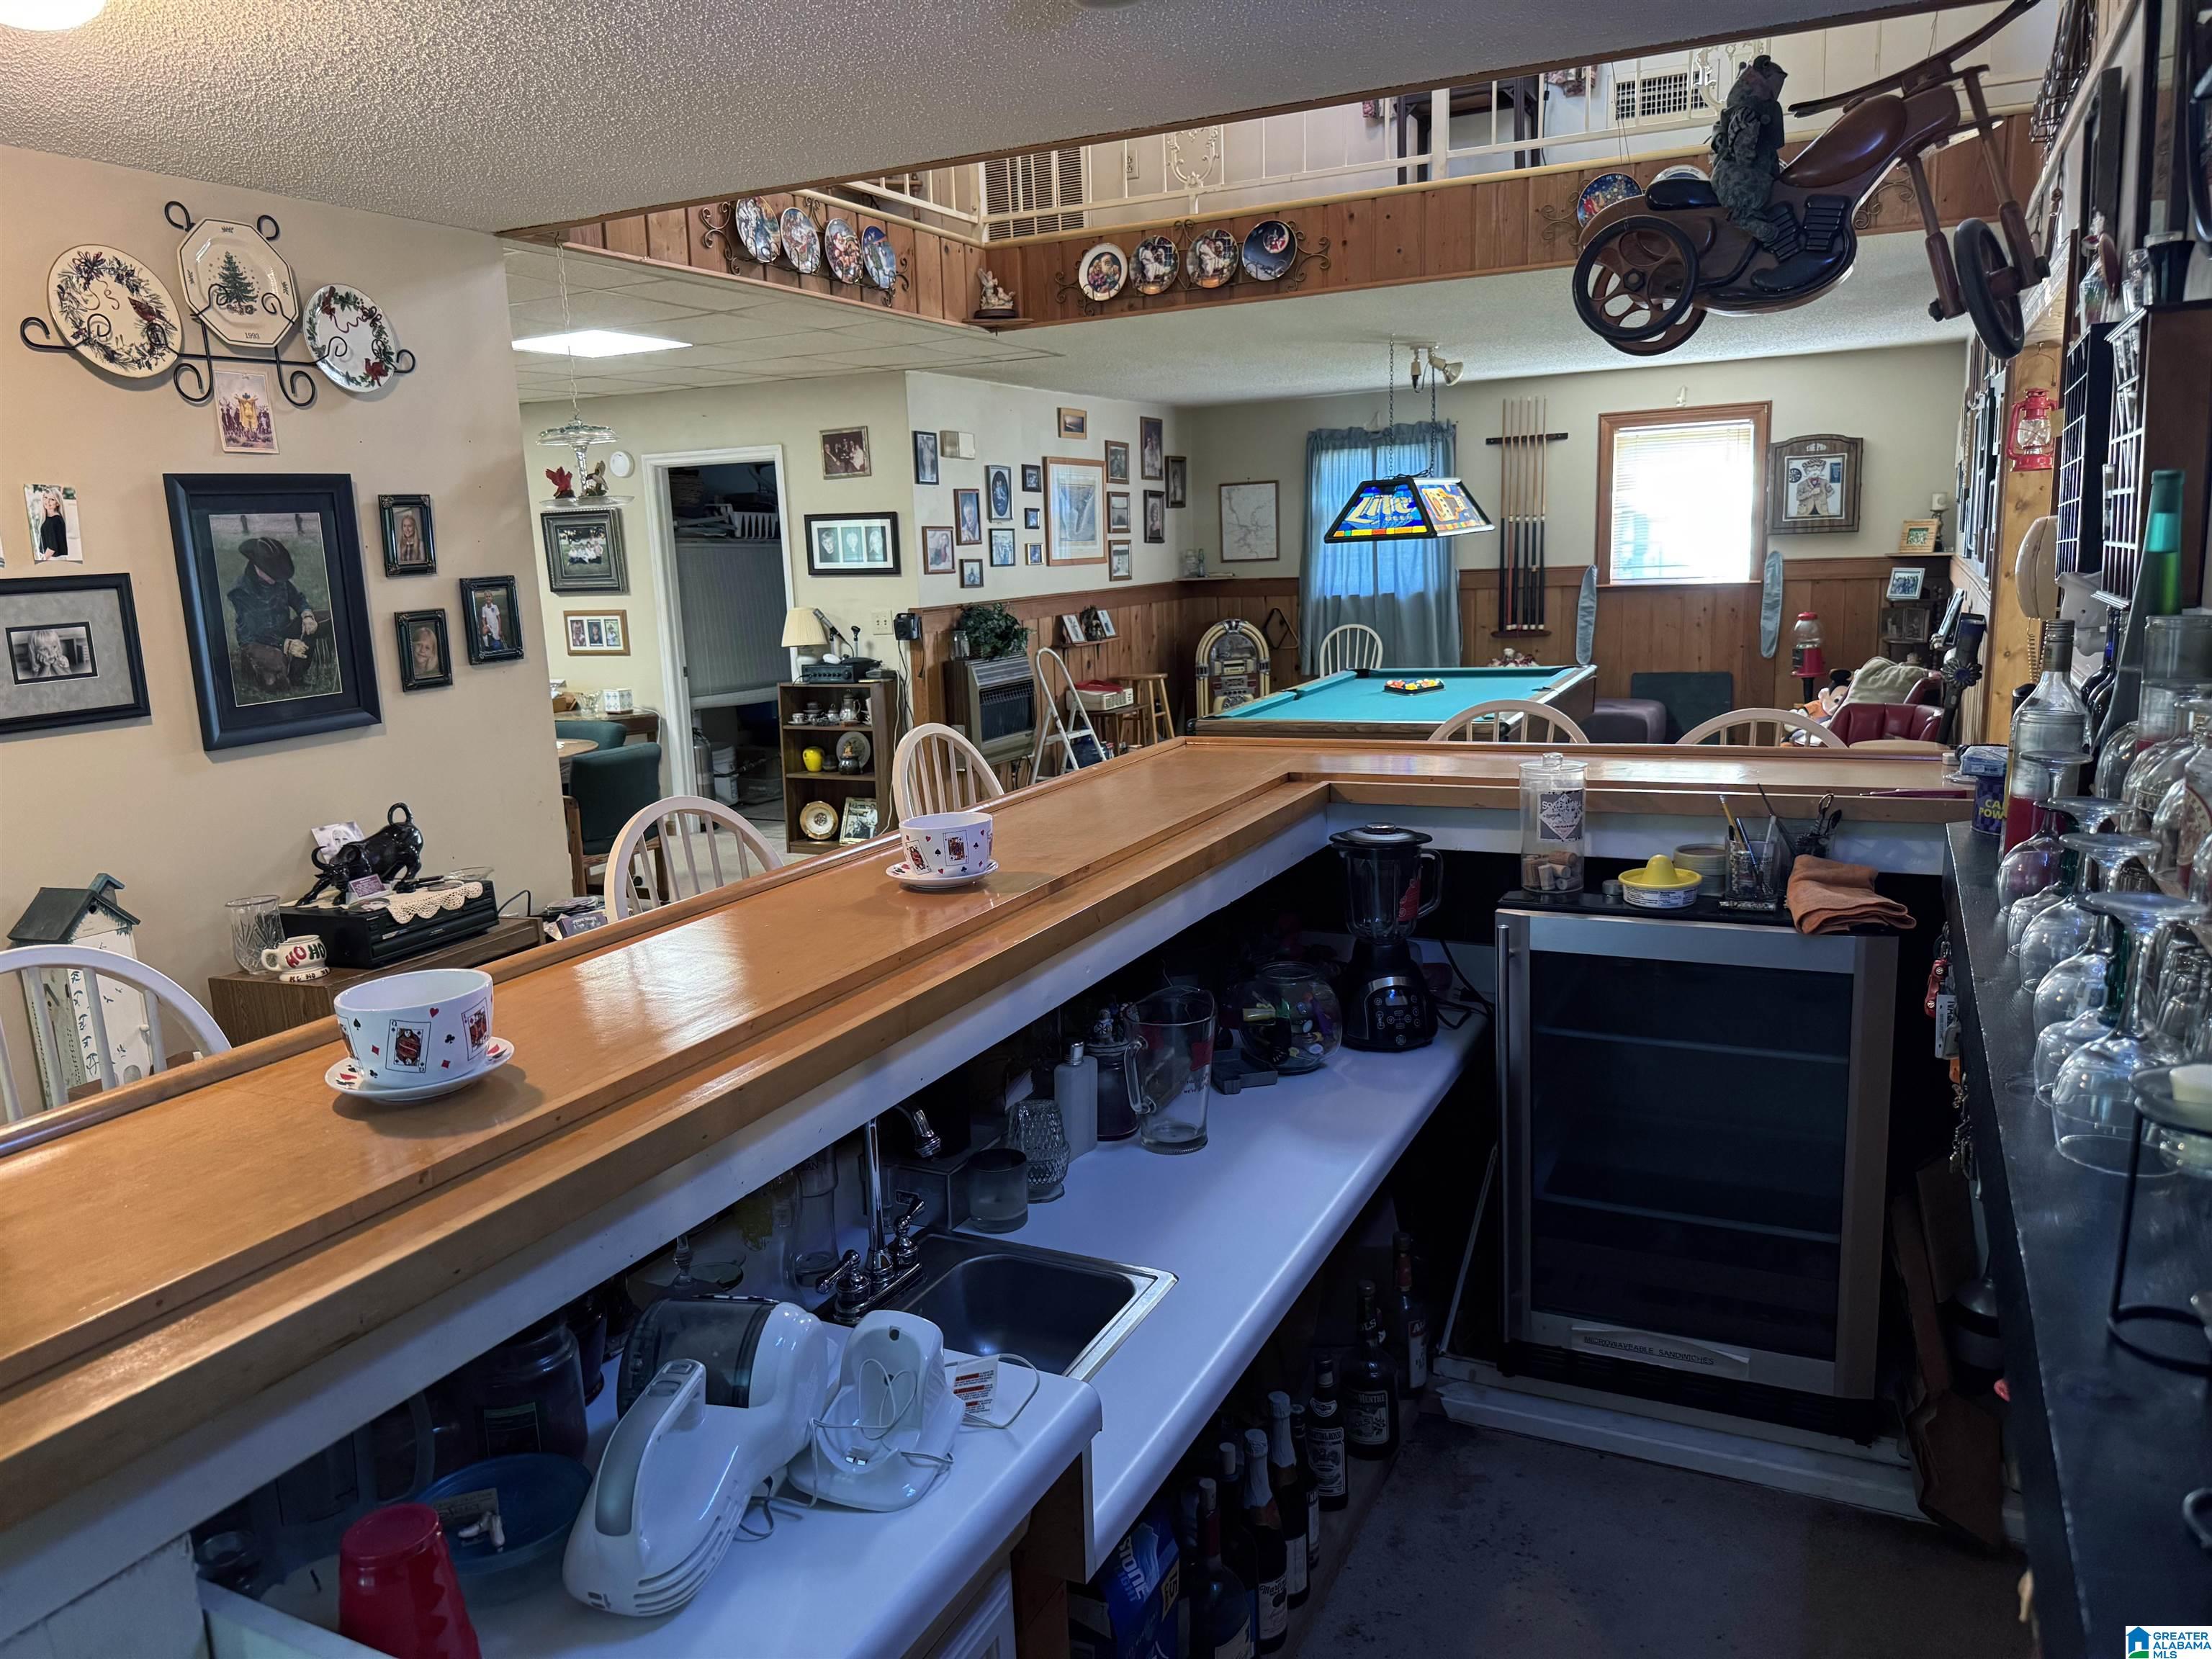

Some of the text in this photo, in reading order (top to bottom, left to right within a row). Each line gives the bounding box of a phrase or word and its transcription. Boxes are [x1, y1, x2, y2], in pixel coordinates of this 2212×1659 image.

[1344, 495, 1413, 524] Lite
[1979, 807, 2005, 819] POW
[1985, 799, 2005, 809] CA
[285, 943, 325, 968] HO HO
[1584, 1336, 1714, 1365] MICROWAVEABLE SANDWICHES
